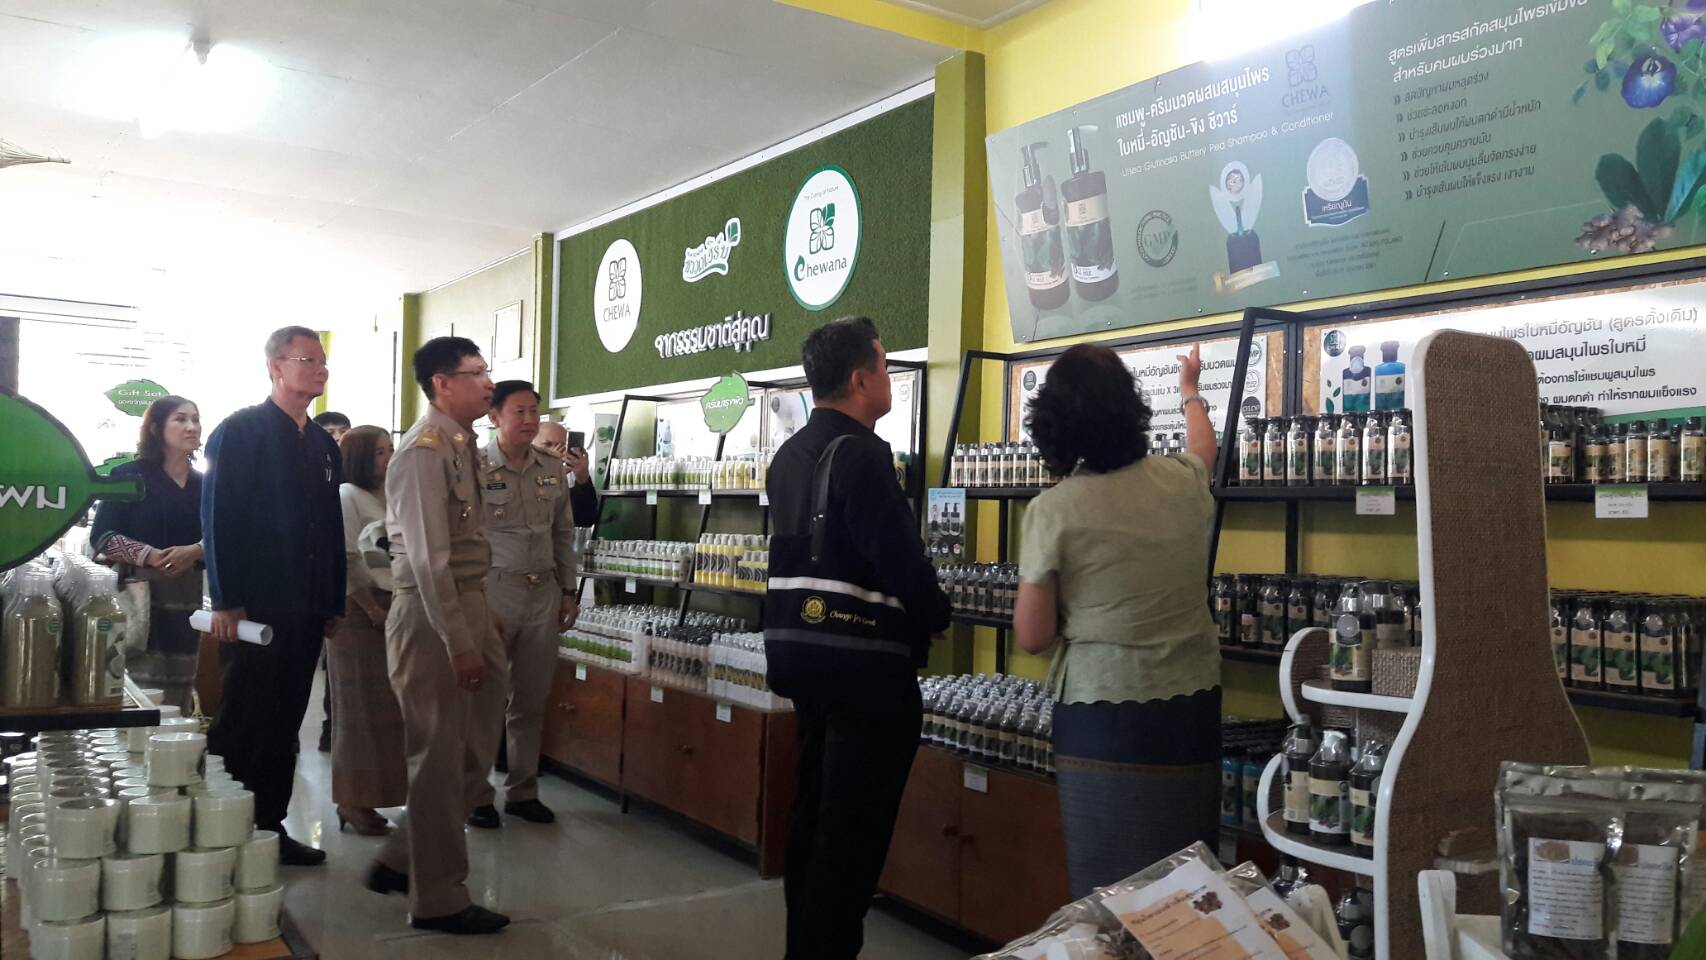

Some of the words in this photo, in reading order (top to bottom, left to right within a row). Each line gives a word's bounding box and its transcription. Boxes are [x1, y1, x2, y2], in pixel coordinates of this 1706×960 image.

[1393, 36, 1523, 83] สำหรับคนผมร่วงมาก
[1115, 66, 1270, 128] แชมพู-ครีมนวดผสมสมุนไพร
[1281, 85, 1330, 108] CHEWA
[1117, 116, 1205, 157] ใบหมี่-อัญชัน-ขิง
[1209, 103, 1238, 130] ชีวาร์
[1209, 141, 1225, 153] Pea
[1228, 130, 1268, 148] Shampoo
[1271, 126, 1279, 136] &
[1281, 111, 1334, 133] Conditioner
[603, 307, 631, 322] CHEWA
[1609, 306, 1698, 332] (สูตรดั้งเดิม)
[655, 311, 771, 358] จากธรรมชาติสู่คุณ
[118, 389, 140, 397] Gift
[1598, 385, 1697, 402] ทำให้รากผมแข็งแรง
